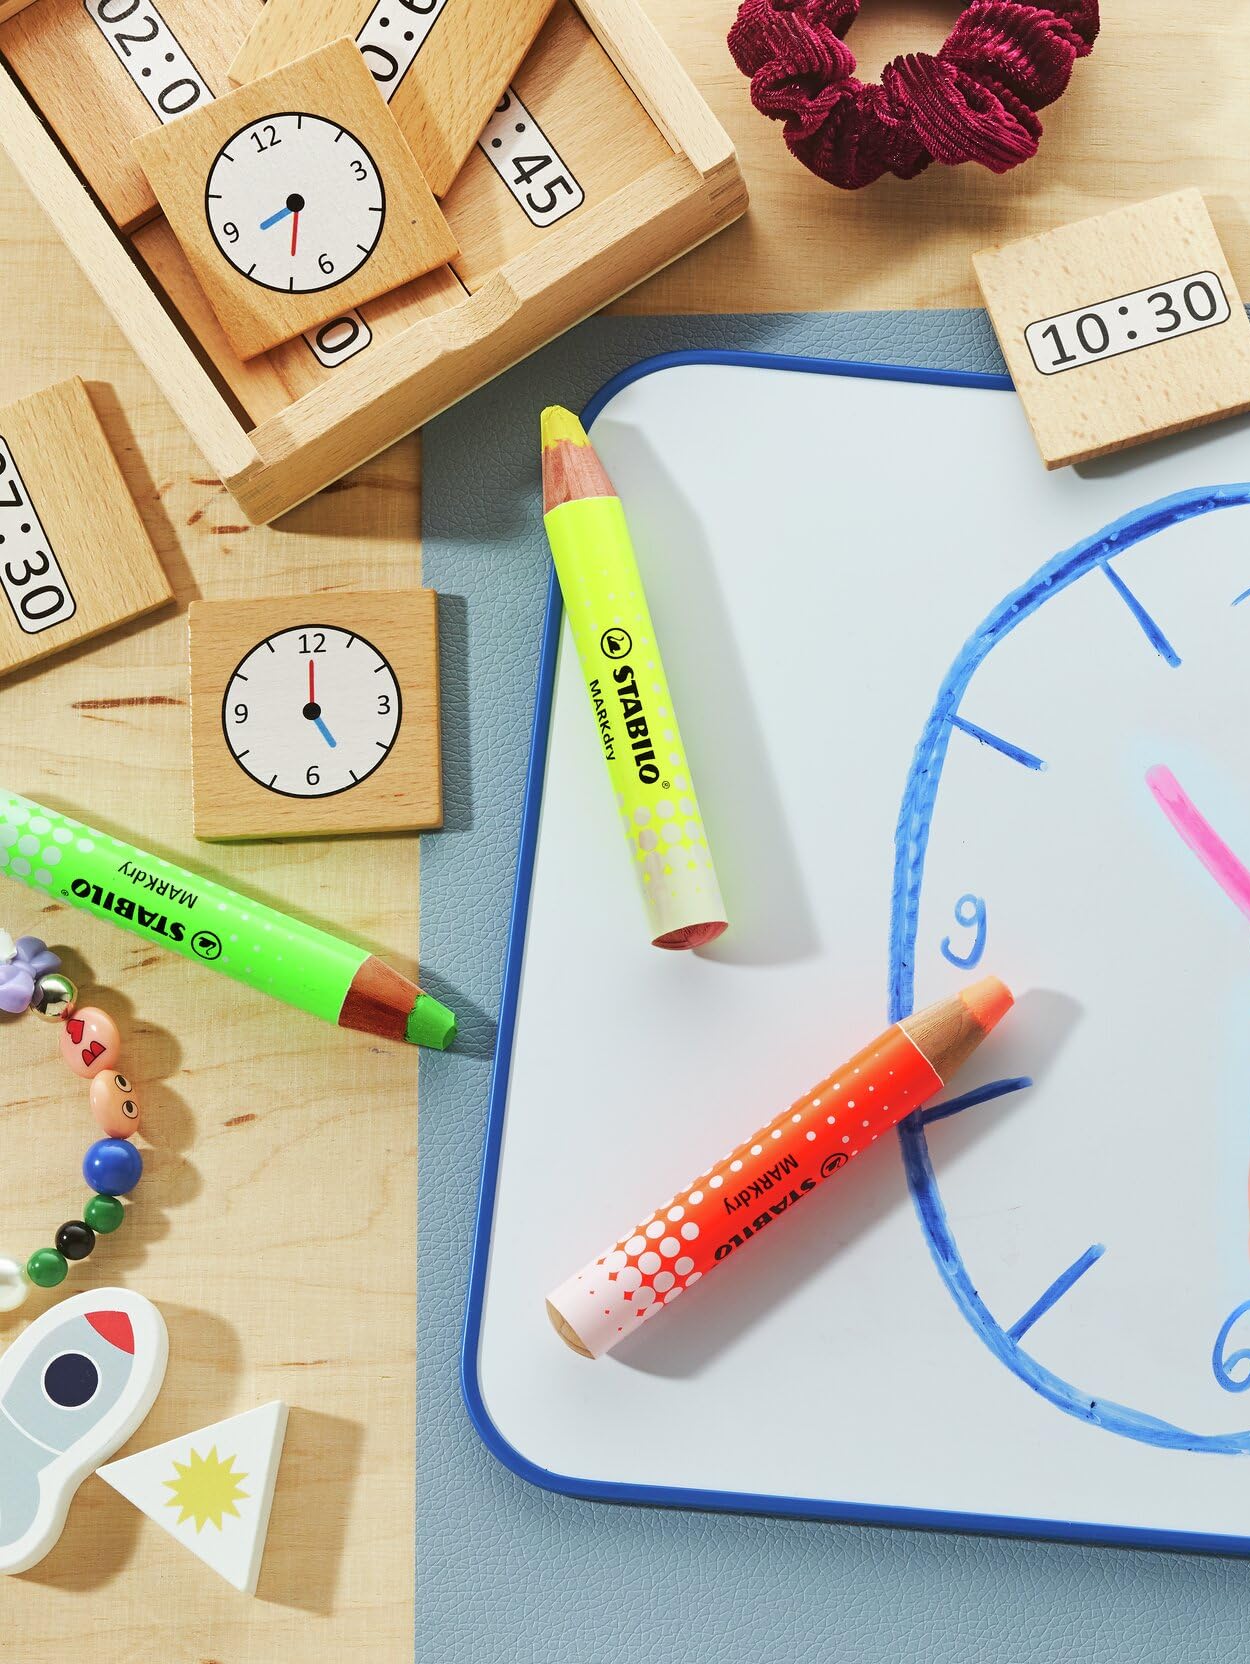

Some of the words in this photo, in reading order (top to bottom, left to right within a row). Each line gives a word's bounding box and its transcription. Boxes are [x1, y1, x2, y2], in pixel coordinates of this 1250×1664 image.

[250, 124, 282, 153] 12
[488, 92, 574, 214] :45
[349, 160, 367, 181] 3
[223, 221, 240, 244] 9
[317, 253, 335, 275] 6
[1041, 280, 1217, 366] 10:30
[298, 633, 327, 654] 12
[234, 703, 248, 724] 9
[377, 694, 391, 715] 3
[589, 679, 616, 761] MARKdry
[306, 765, 320, 785] 6
[118, 861, 198, 909] MARKdry
[940, 893, 987, 970] 9
[723, 1154, 799, 1215] MARKdry
[714, 1178, 816, 1261] STABILO
